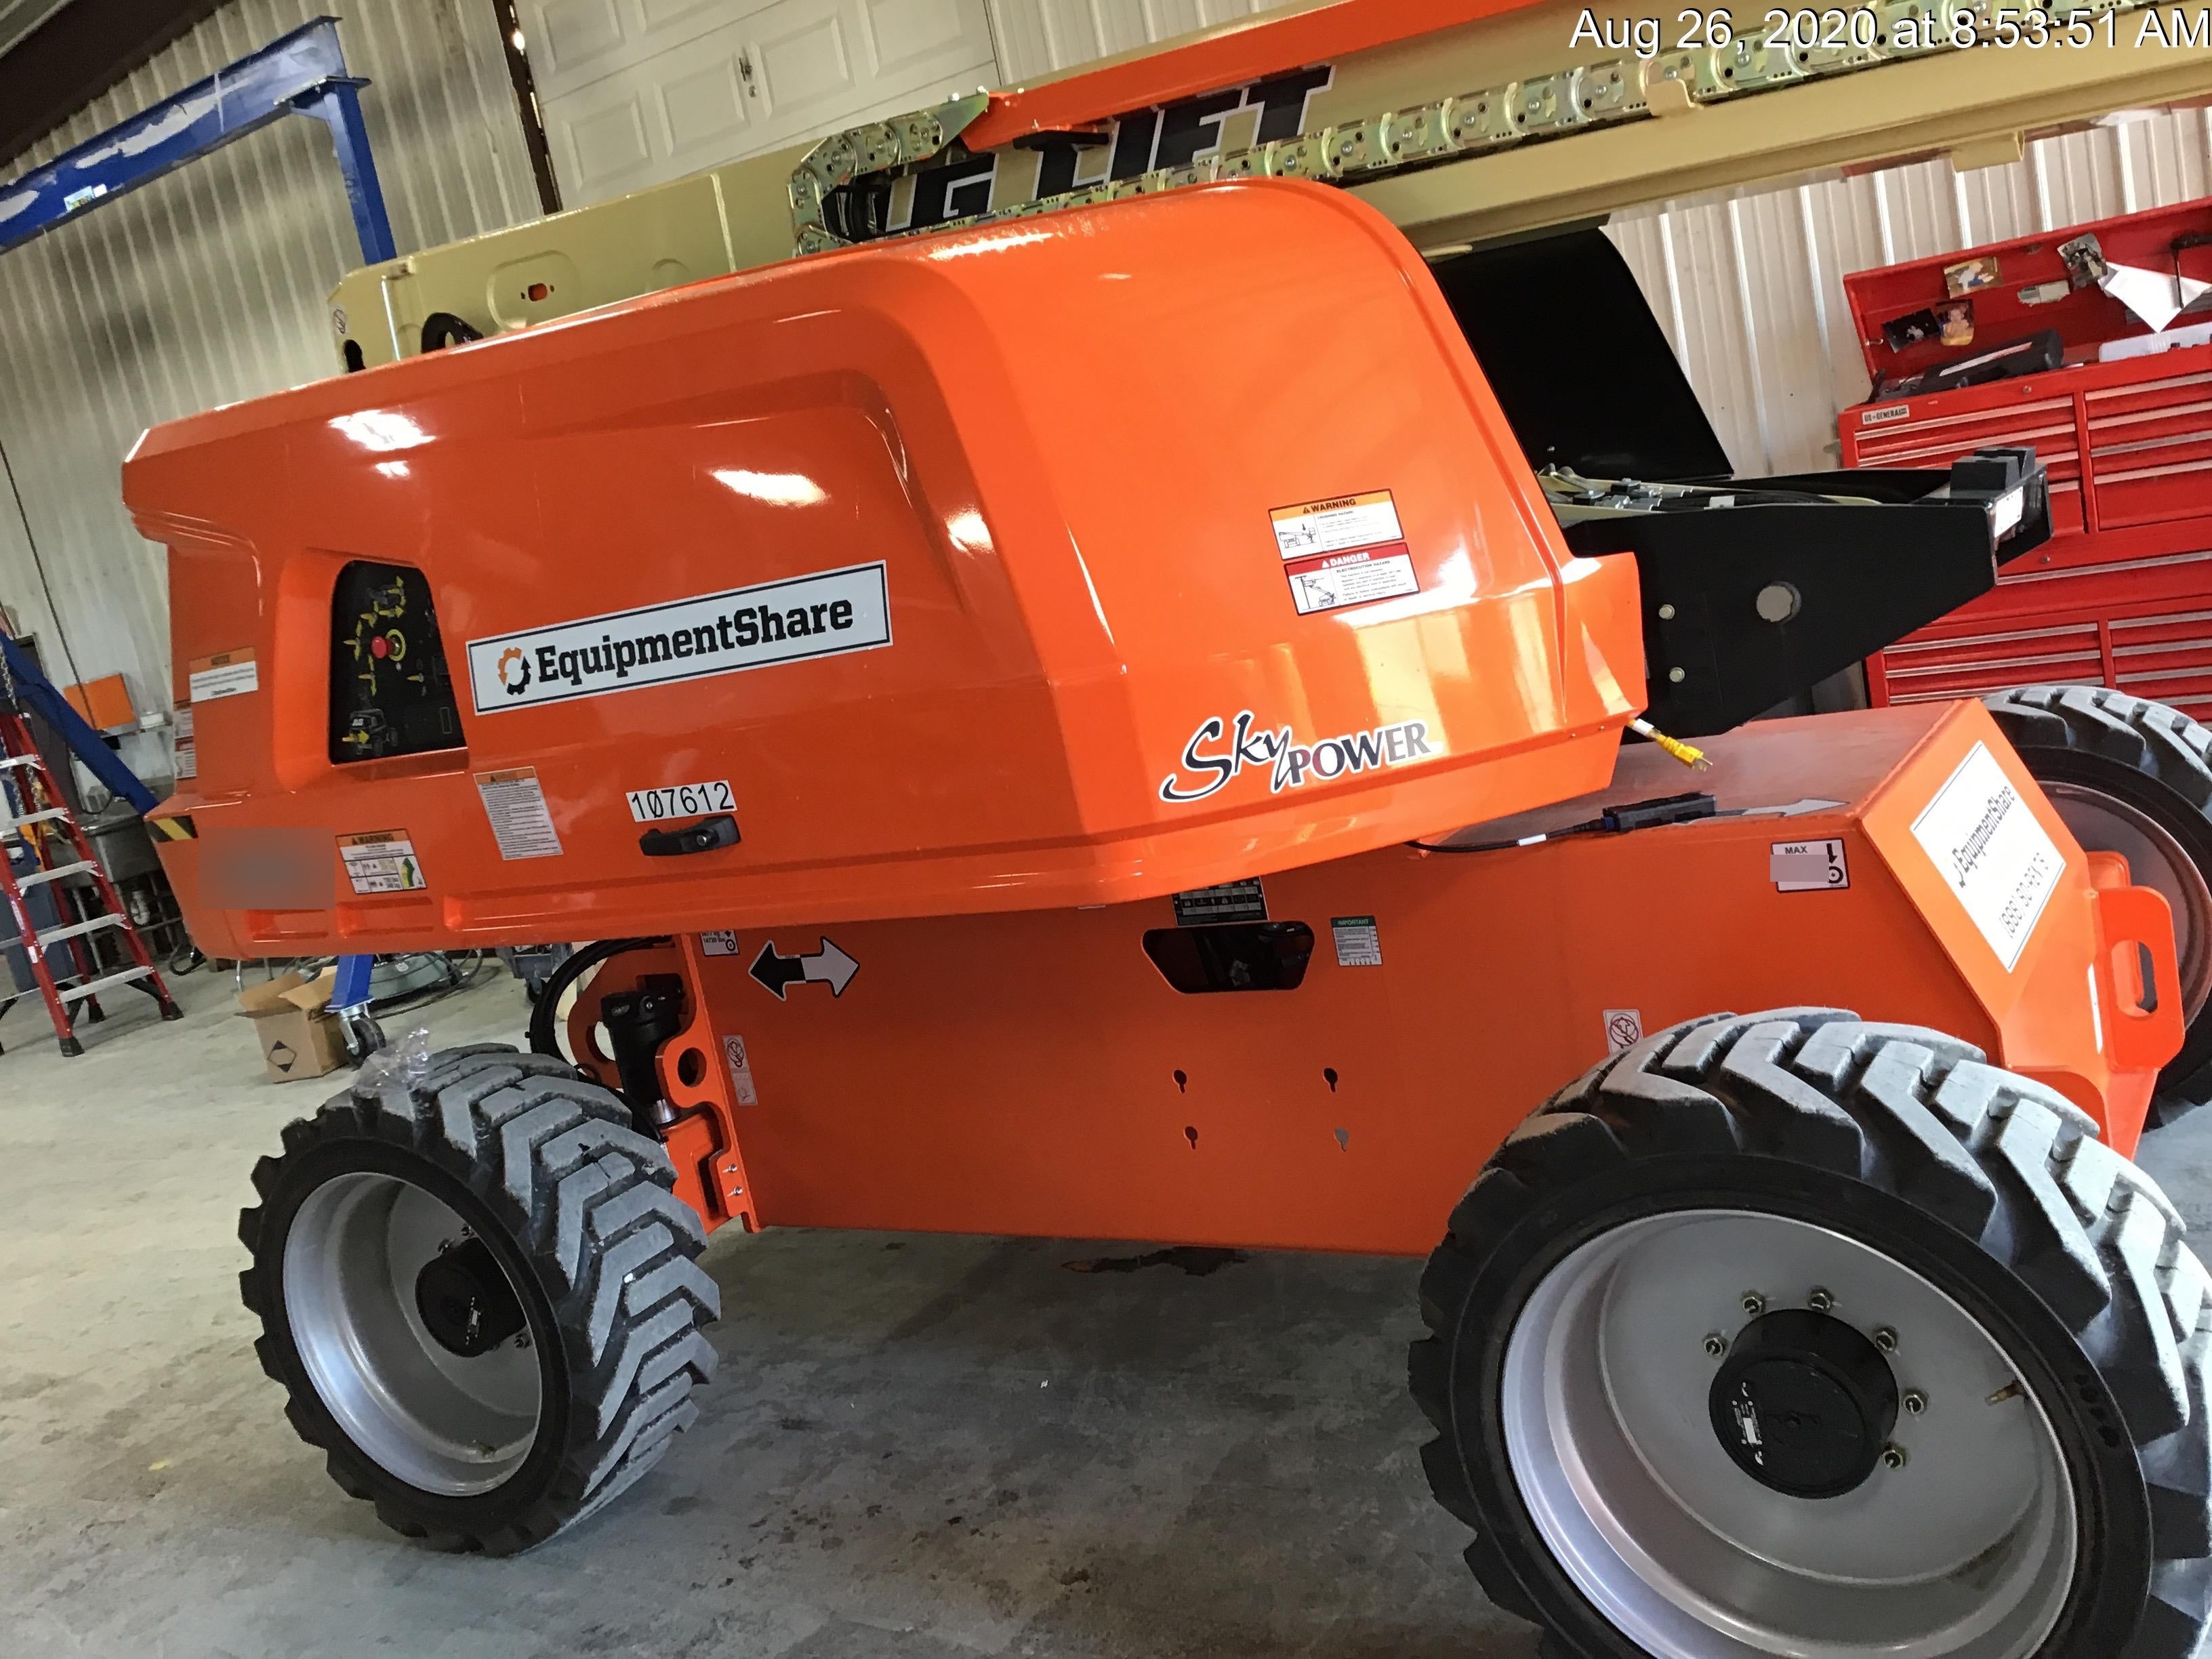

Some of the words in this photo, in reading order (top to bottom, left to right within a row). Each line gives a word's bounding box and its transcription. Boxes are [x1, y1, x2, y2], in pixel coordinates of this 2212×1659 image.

[1033, 64, 1335, 202] LIFT
[1311, 498, 1357, 512] WARNING
[1329, 552, 1370, 567] DANGER
[535, 599, 854, 686] EquipmentShare
[632, 782, 735, 819] 107612
[1951, 785, 2015, 874] EquipmentShare
[1784, 846, 1808, 855] MAX
